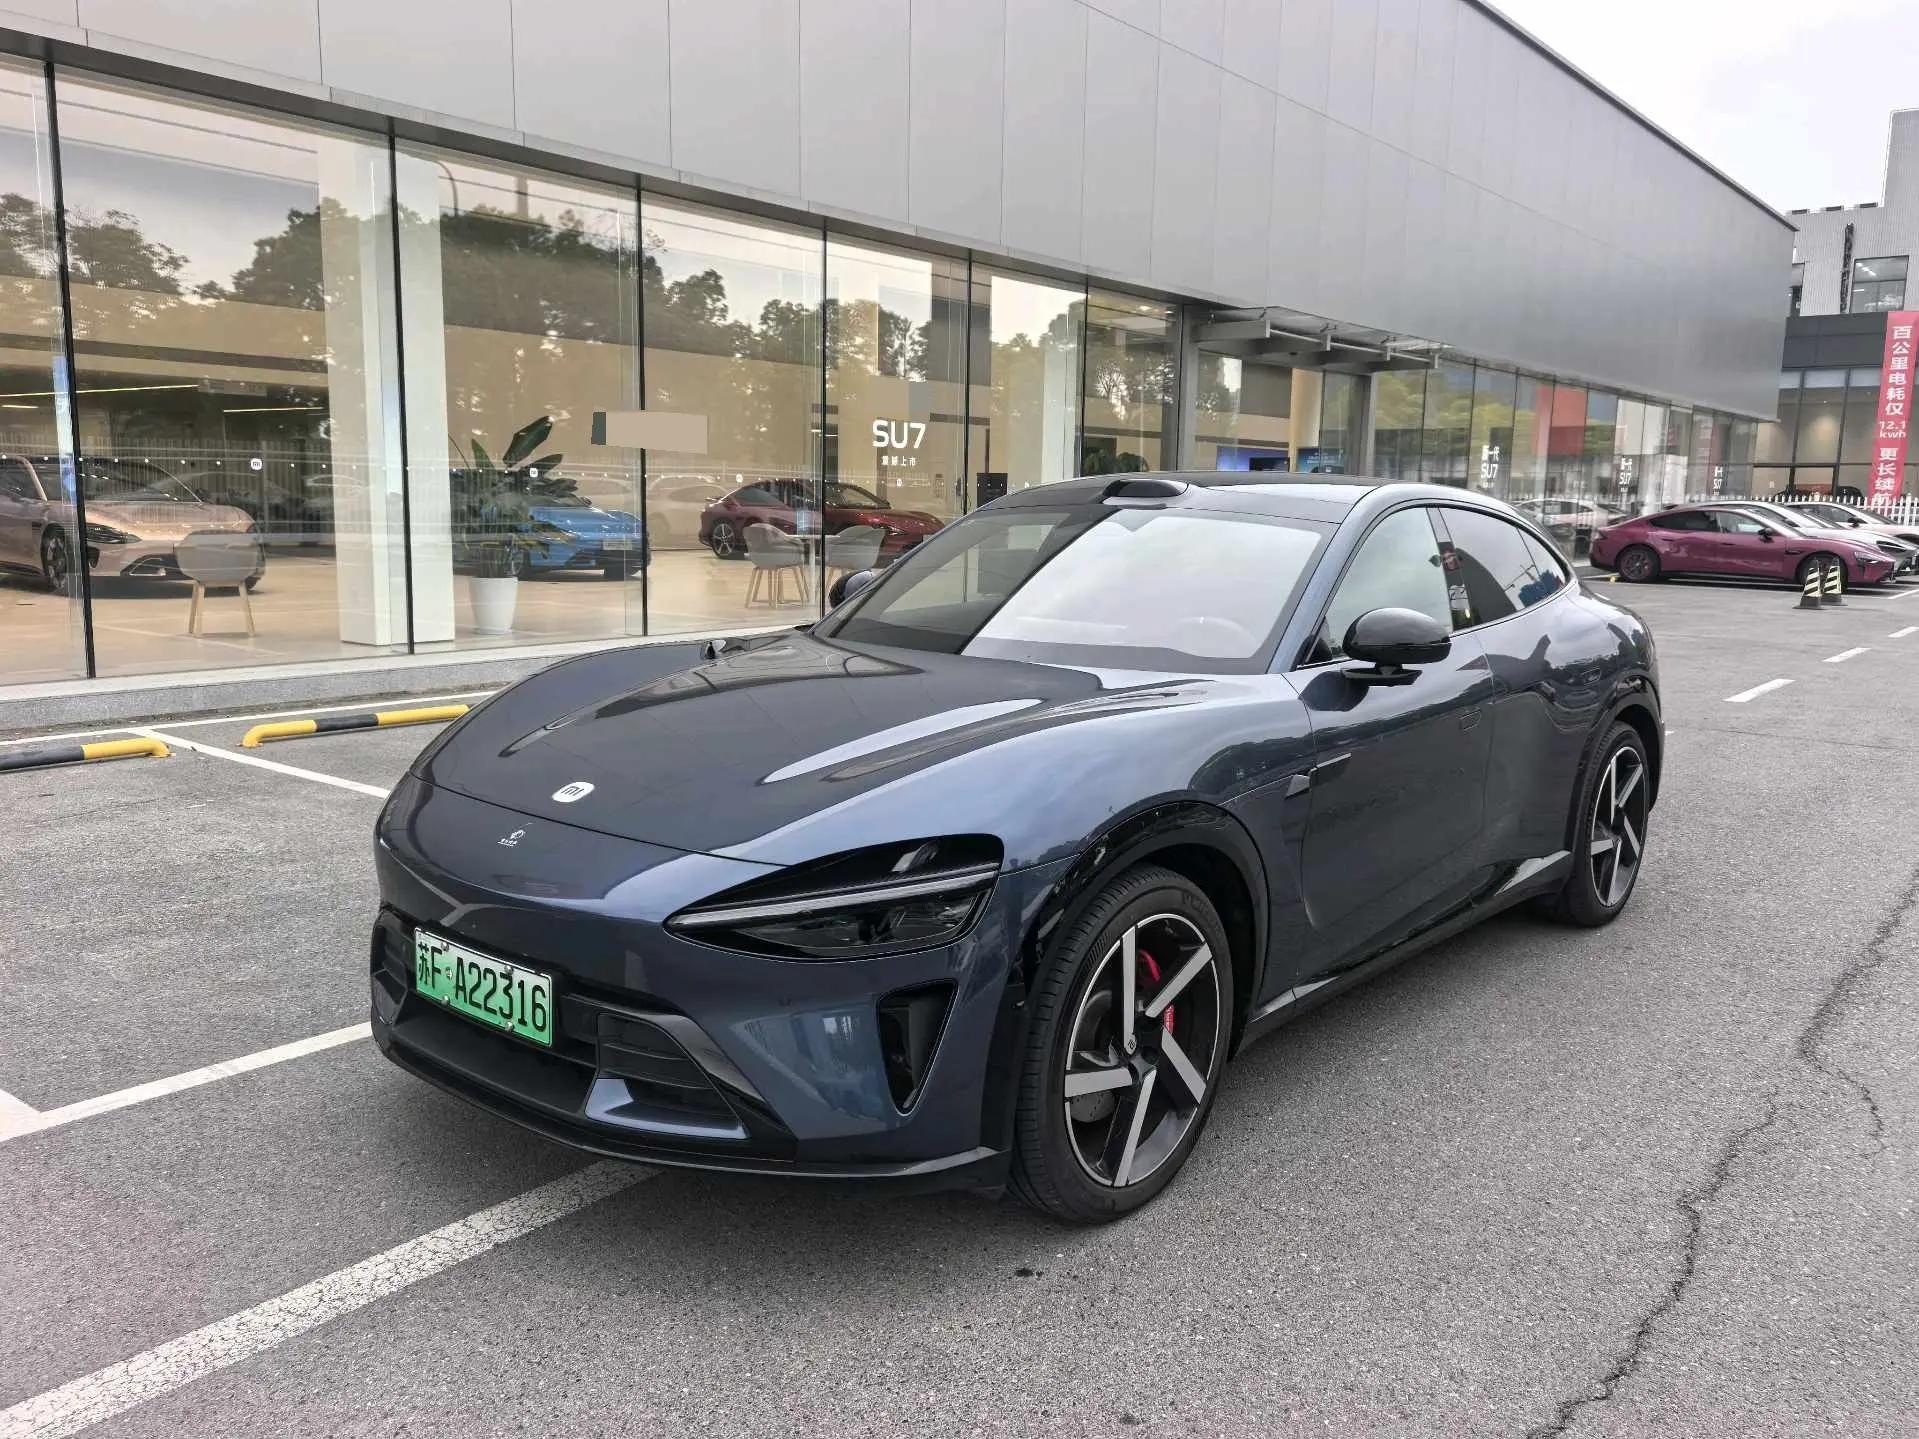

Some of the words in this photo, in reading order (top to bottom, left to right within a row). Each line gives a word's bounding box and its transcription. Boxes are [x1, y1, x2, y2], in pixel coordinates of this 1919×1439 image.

[1885, 325, 1912, 416] 百公里电耗仅
[872, 419, 926, 449] SU7
[1481, 462, 1498, 479] SU7
